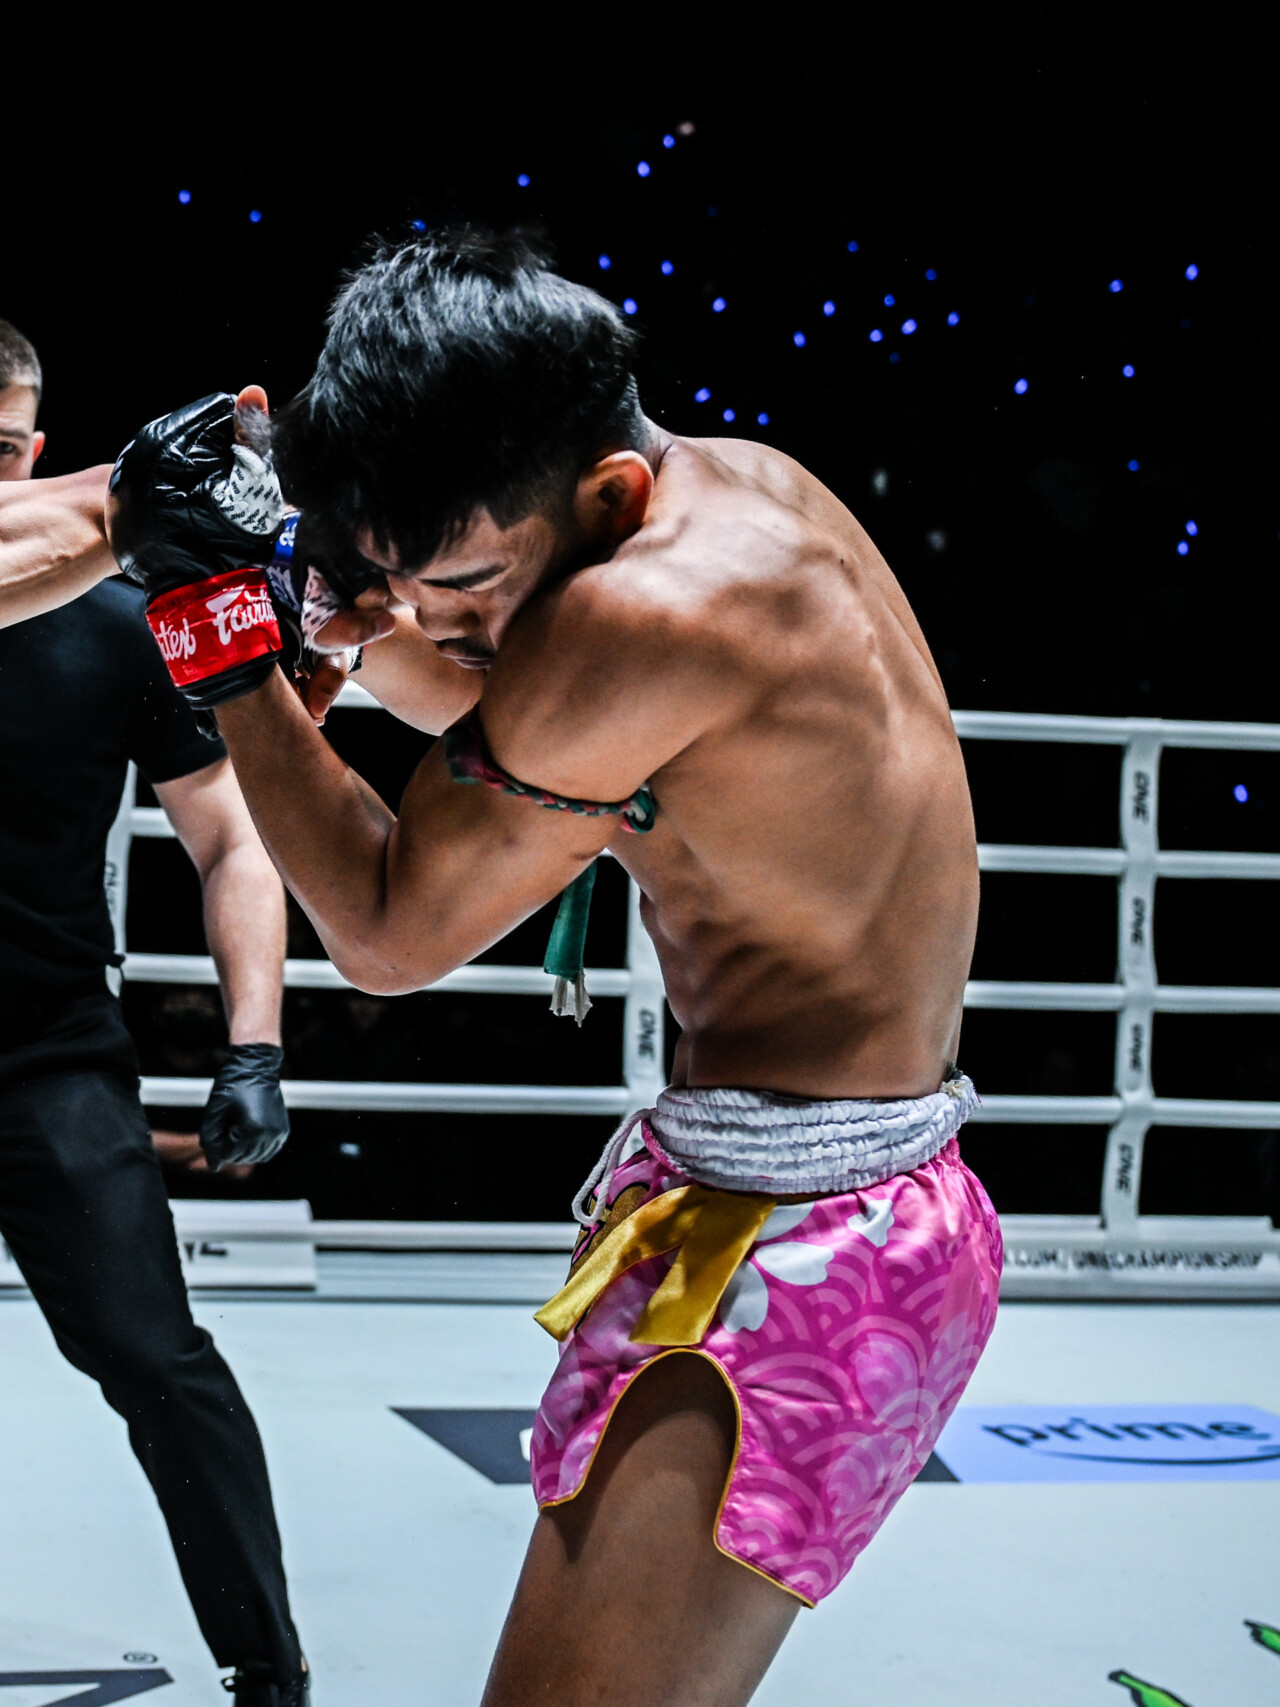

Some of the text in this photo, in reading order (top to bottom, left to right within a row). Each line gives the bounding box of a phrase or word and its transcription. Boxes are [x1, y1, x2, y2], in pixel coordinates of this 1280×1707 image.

[1133, 771, 1150, 824] ONE
[1131, 896, 1145, 946] ONE
[638, 1008, 656, 1061] ONE
[1116, 1143, 1134, 1195] ONE
[981, 1416, 1272, 1448] prime
